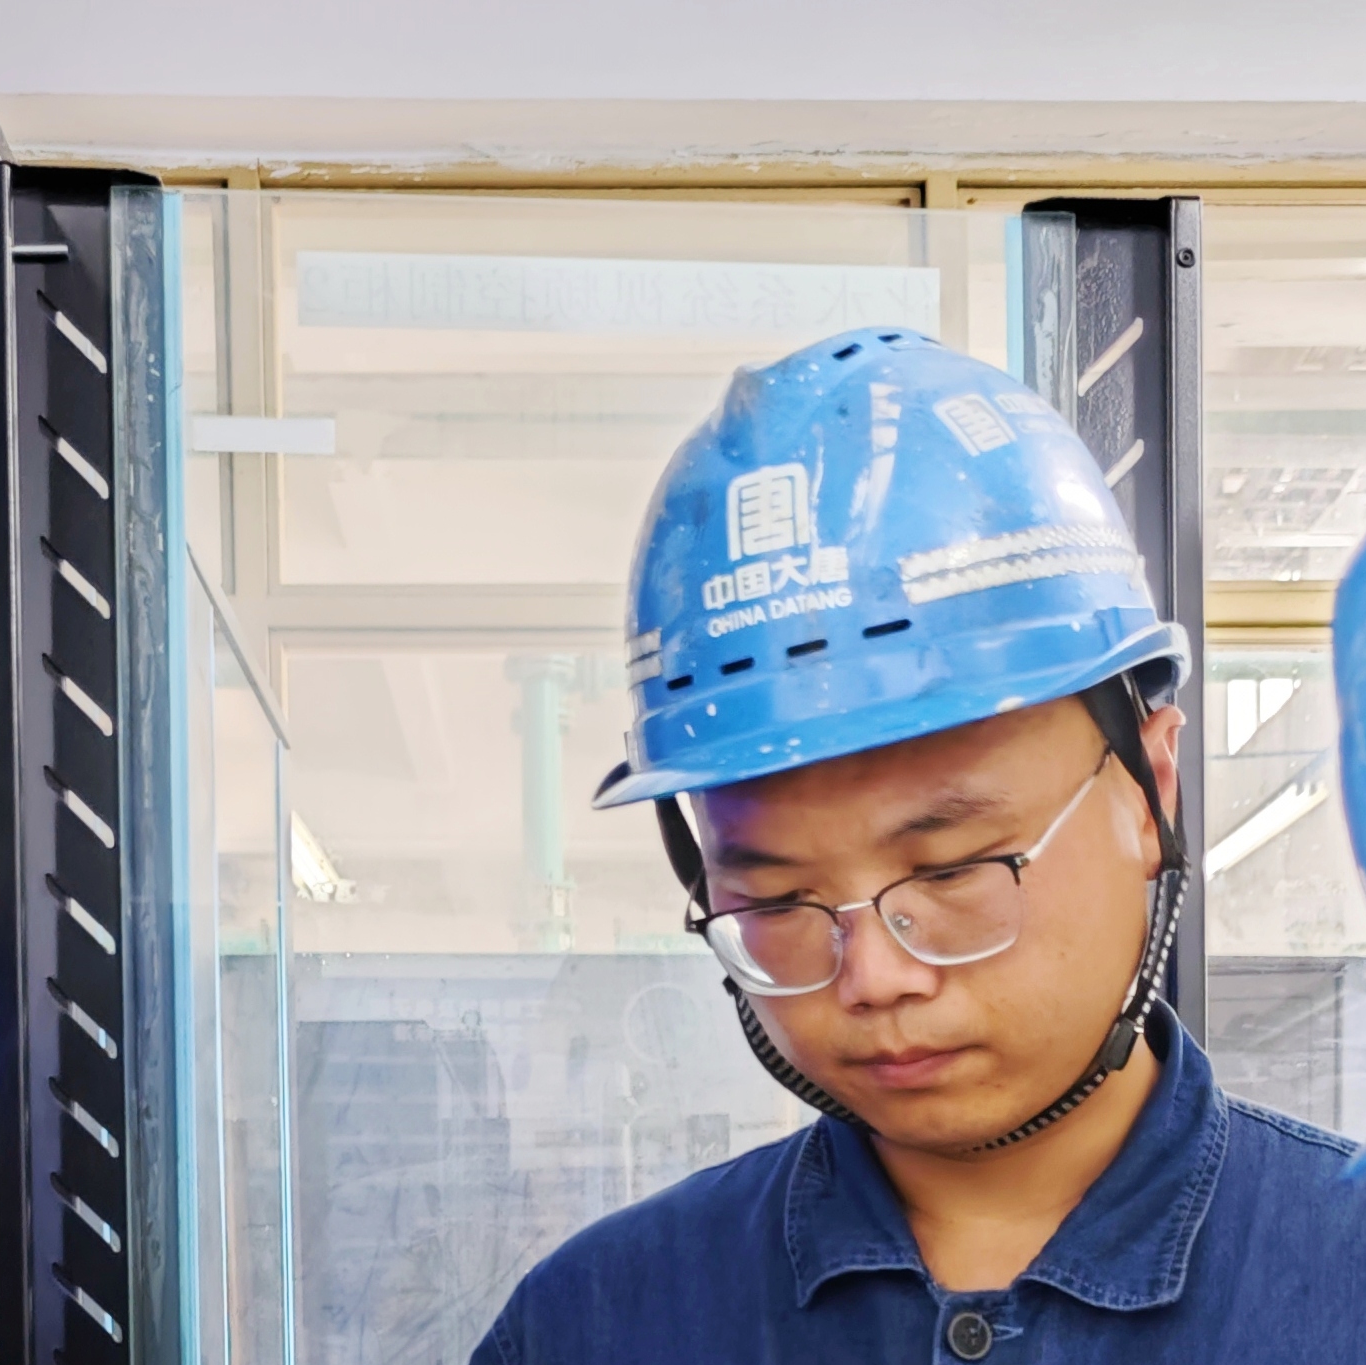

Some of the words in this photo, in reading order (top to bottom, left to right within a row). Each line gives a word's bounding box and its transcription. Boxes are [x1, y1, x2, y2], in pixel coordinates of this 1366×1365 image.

[702, 546, 850, 611] 中国大唐
[707, 604, 767, 638] CHINA
[769, 586, 853, 620] DATANG
